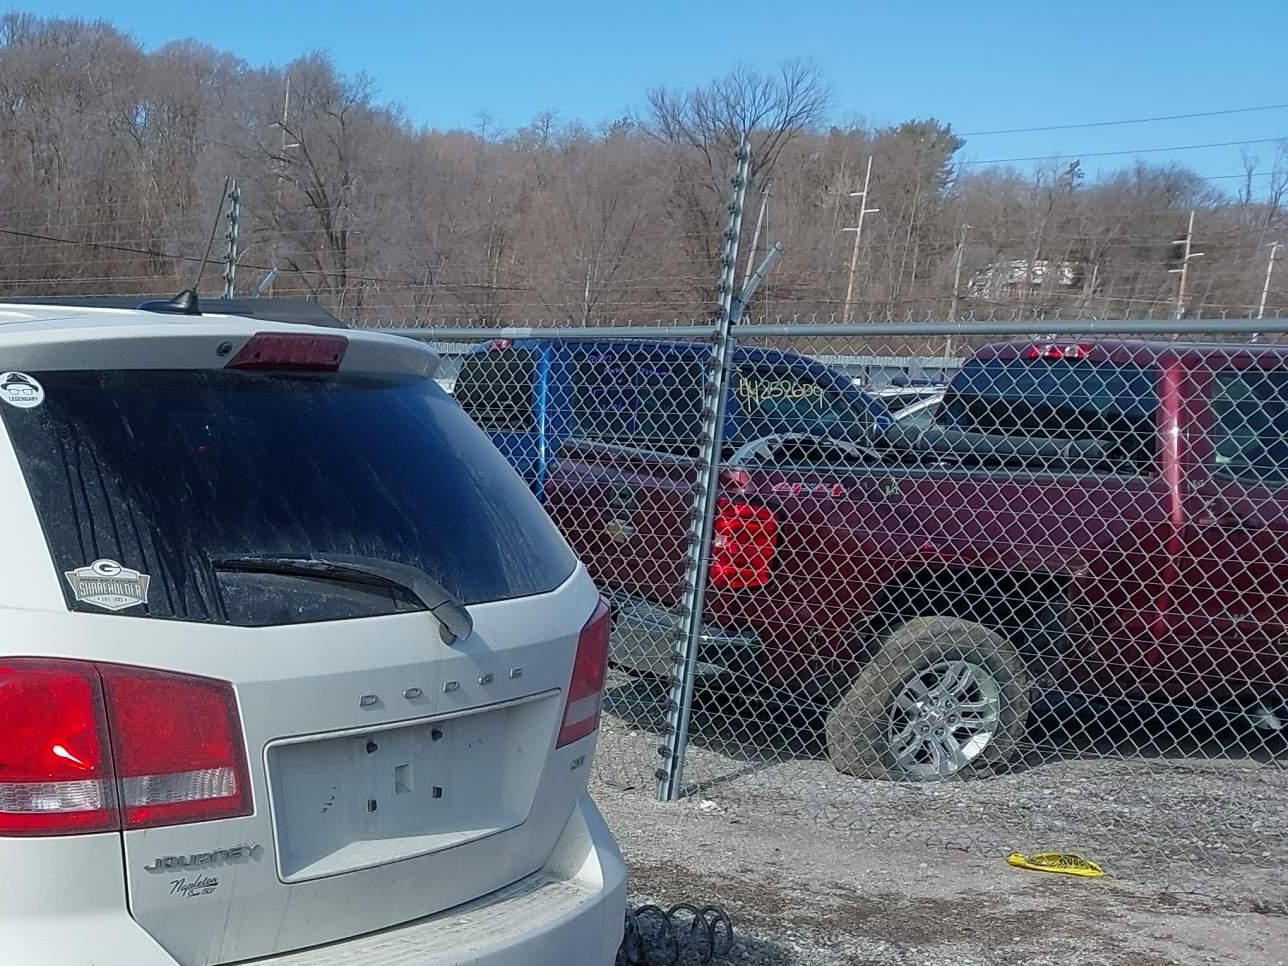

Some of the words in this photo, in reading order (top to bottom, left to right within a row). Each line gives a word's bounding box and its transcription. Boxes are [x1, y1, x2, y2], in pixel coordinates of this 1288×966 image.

[79, 582, 142, 598] SHAREHOLDER
[359, 666, 523, 707] DODGE
[144, 844, 264, 872] JOURNEY
[169, 873, 218, 897] Napleton
